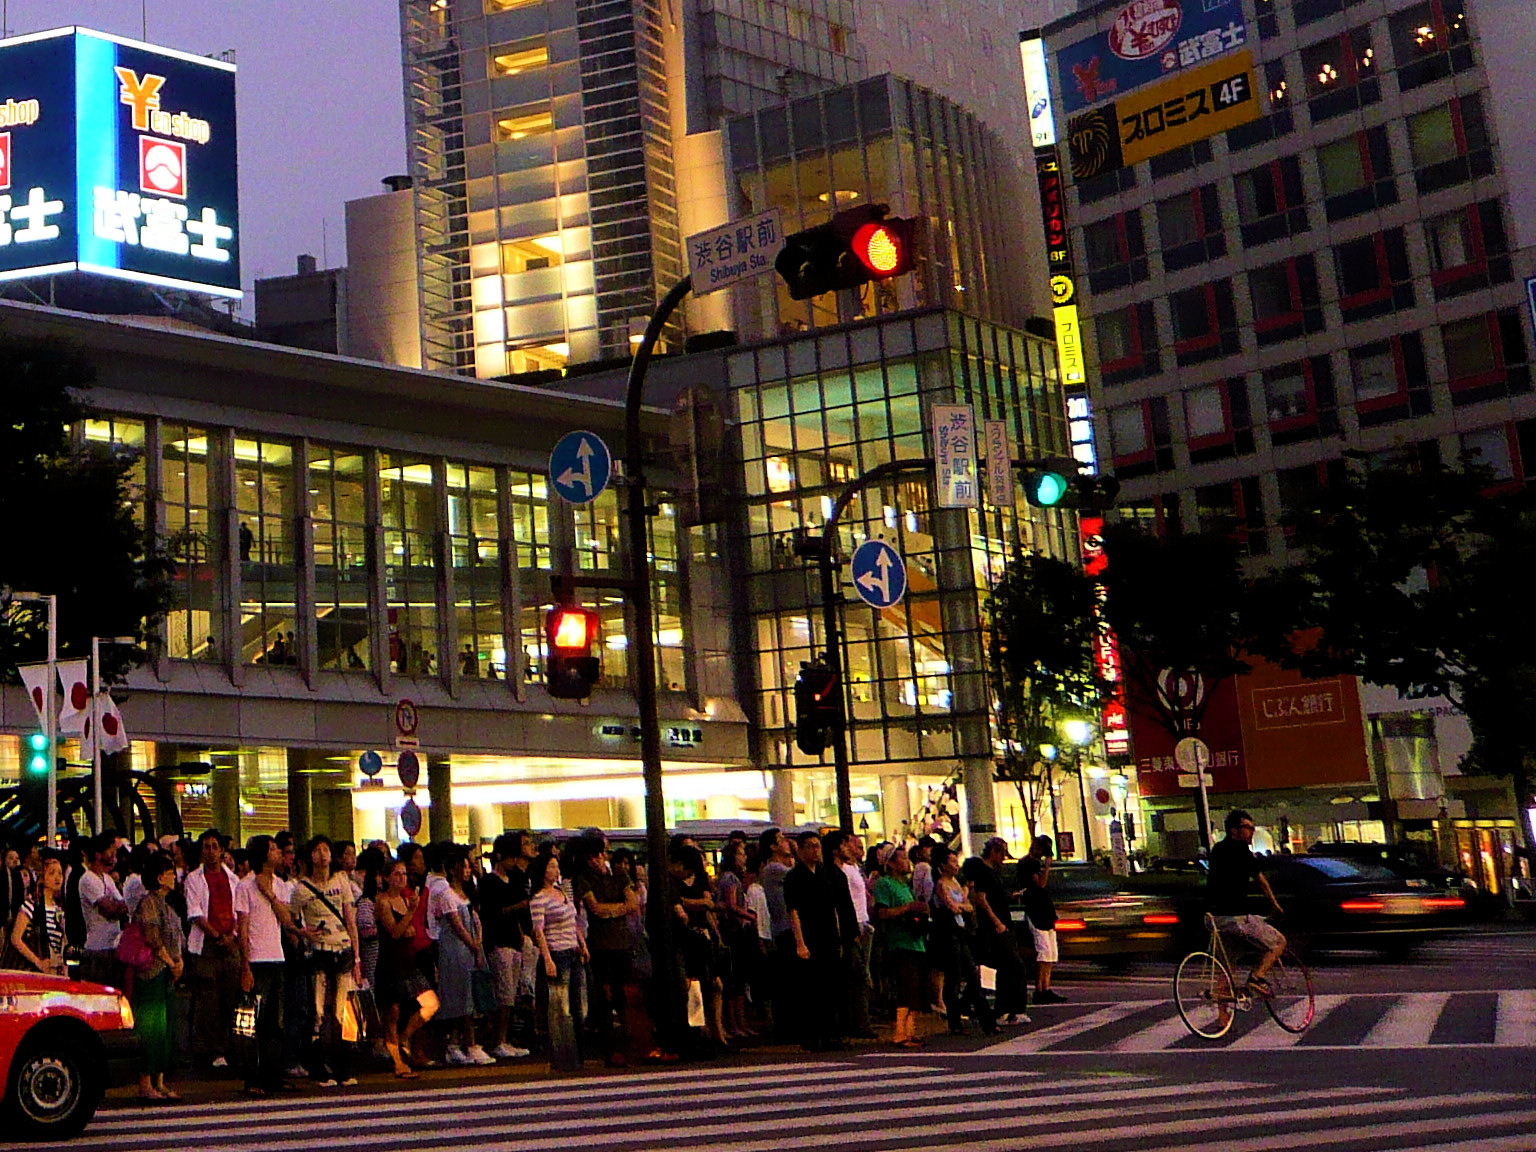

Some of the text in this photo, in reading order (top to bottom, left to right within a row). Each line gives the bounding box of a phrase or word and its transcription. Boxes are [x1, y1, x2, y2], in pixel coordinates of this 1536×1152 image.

[1178, 21, 1245, 67] 武富士
[171, 110, 211, 145] shop
[1121, 78, 1245, 146] プロミス 4F
[92, 185, 234, 263] 武富士
[694, 217, 777, 269] 渋谷駅前
[710, 260, 748, 283] Shibuya
[939, 425, 949, 465] Shibuya
[950, 412, 972, 499] 渋谷駅前
